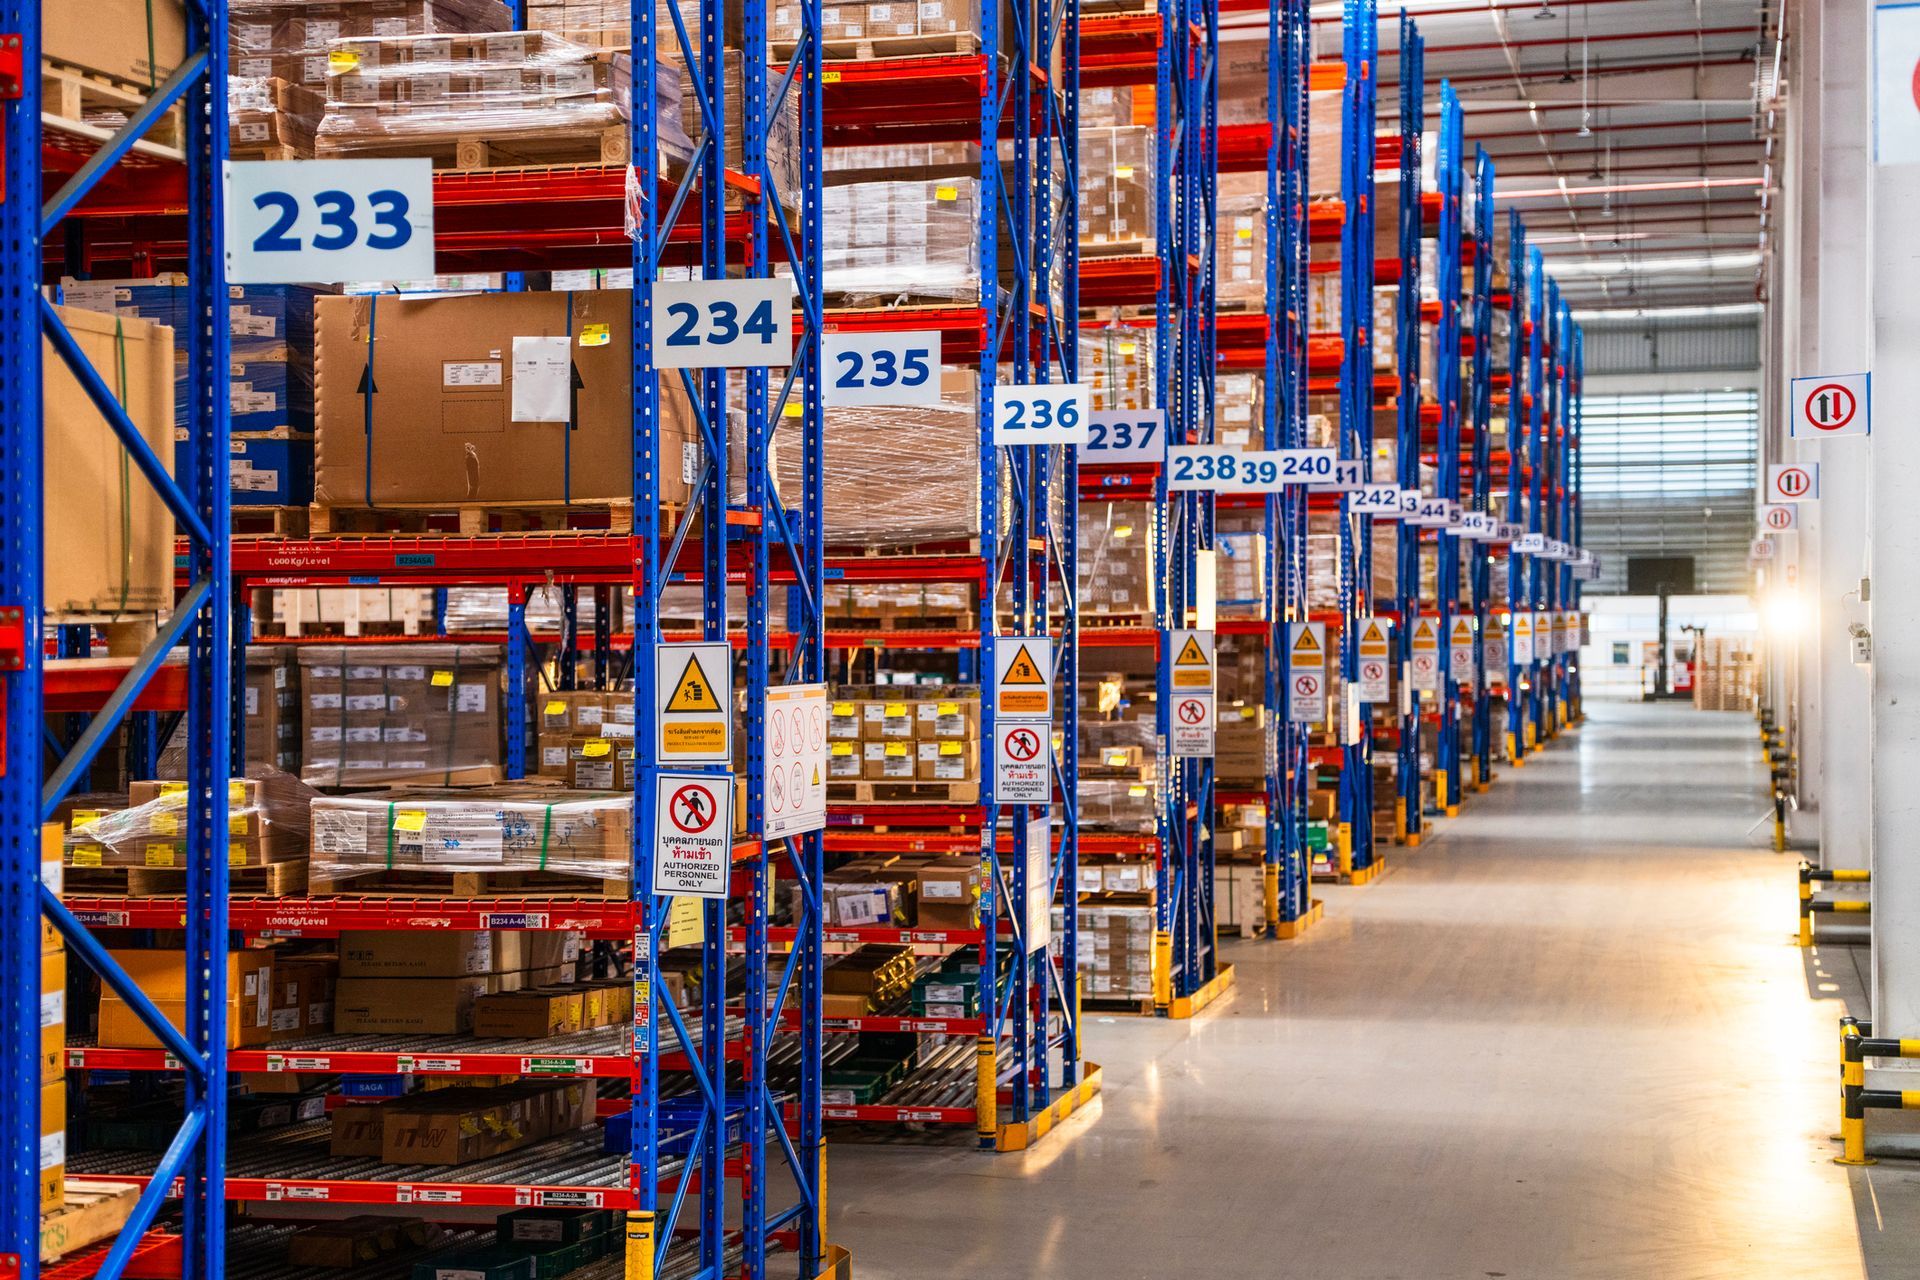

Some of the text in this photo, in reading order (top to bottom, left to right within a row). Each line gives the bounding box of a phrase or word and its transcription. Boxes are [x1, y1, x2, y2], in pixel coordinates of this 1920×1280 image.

[253, 189, 412, 252] 233
[666, 300, 778, 346] 234
[836, 349, 930, 388] 235
[1003, 399, 1079, 430] 236
[1087, 422, 1158, 450] 237
[1174, 455, 1236, 481] 238
[1242, 461, 1277, 484] 39
[1283, 457, 1331, 475] 240
[1336, 466, 1357, 484] 41
[1355, 489, 1396, 505] 242
[1421, 503, 1444, 517] 44
[1463, 516, 1482, 528] 46
[662, 836, 723, 848] บุคคลภายนอก
[672, 846, 712, 860] ห้ามเข้า
[663, 861, 720, 871] AUTHORIZED
[664, 870, 718, 880] PERSONNEL
[678, 879, 703, 888] ONLY
[394, 1128, 447, 1149] ITW
